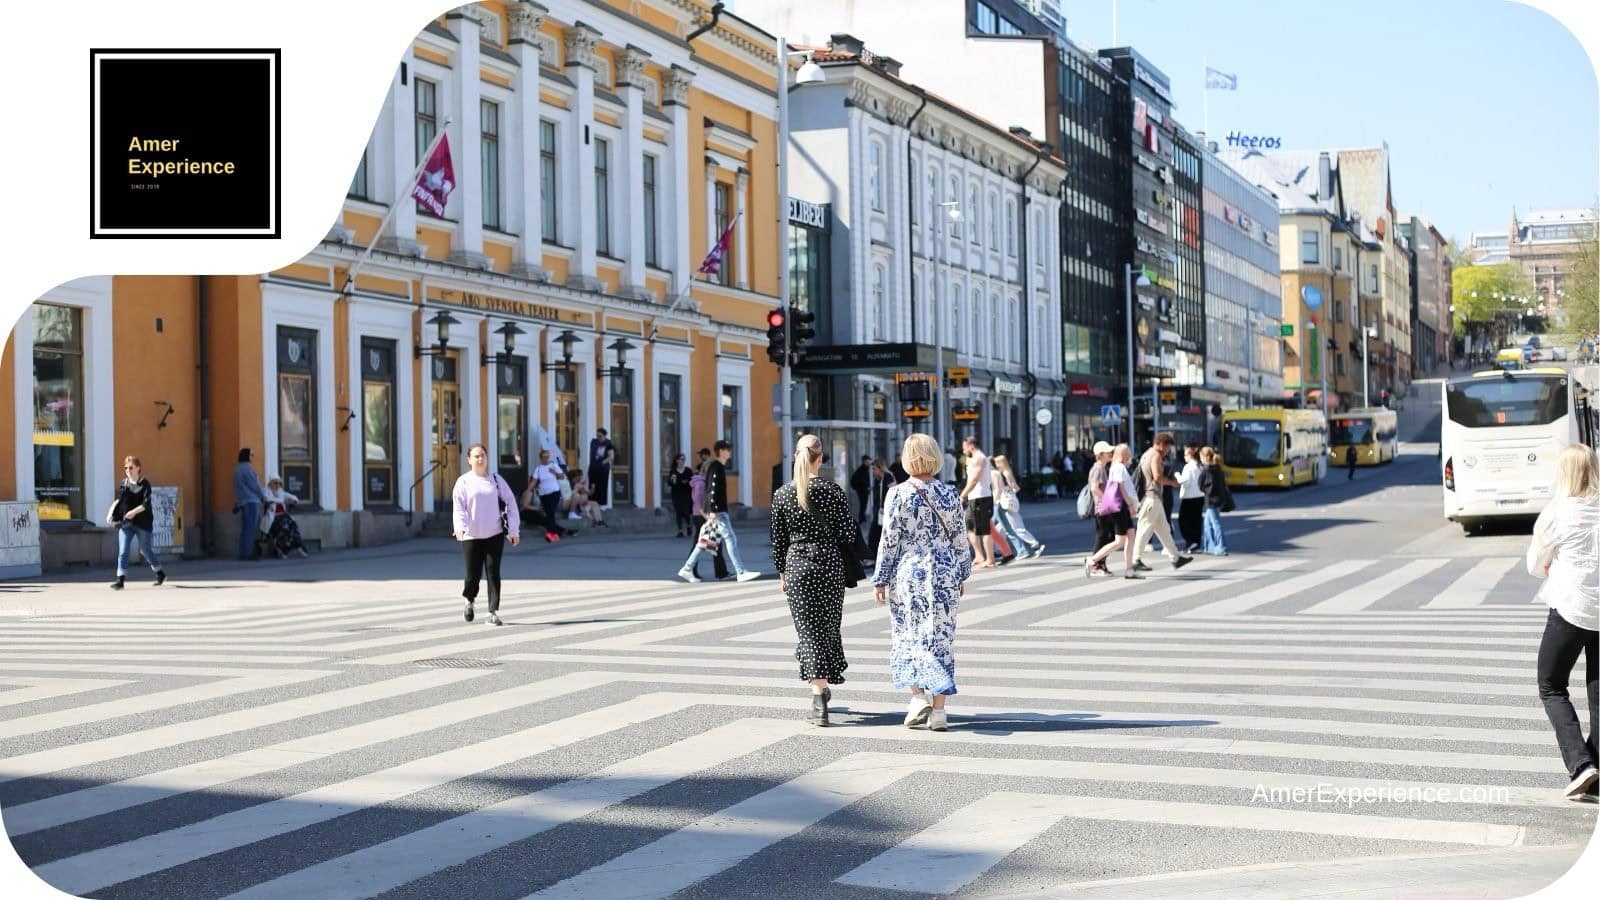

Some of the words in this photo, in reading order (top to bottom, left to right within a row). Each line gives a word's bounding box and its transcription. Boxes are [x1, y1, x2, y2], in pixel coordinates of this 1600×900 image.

[1226, 131, 1281, 149] Heeros
[788, 197, 825, 229] ELIBERI
[485, 296, 524, 315] SVENSKA
[528, 304, 559, 320] TEATER
